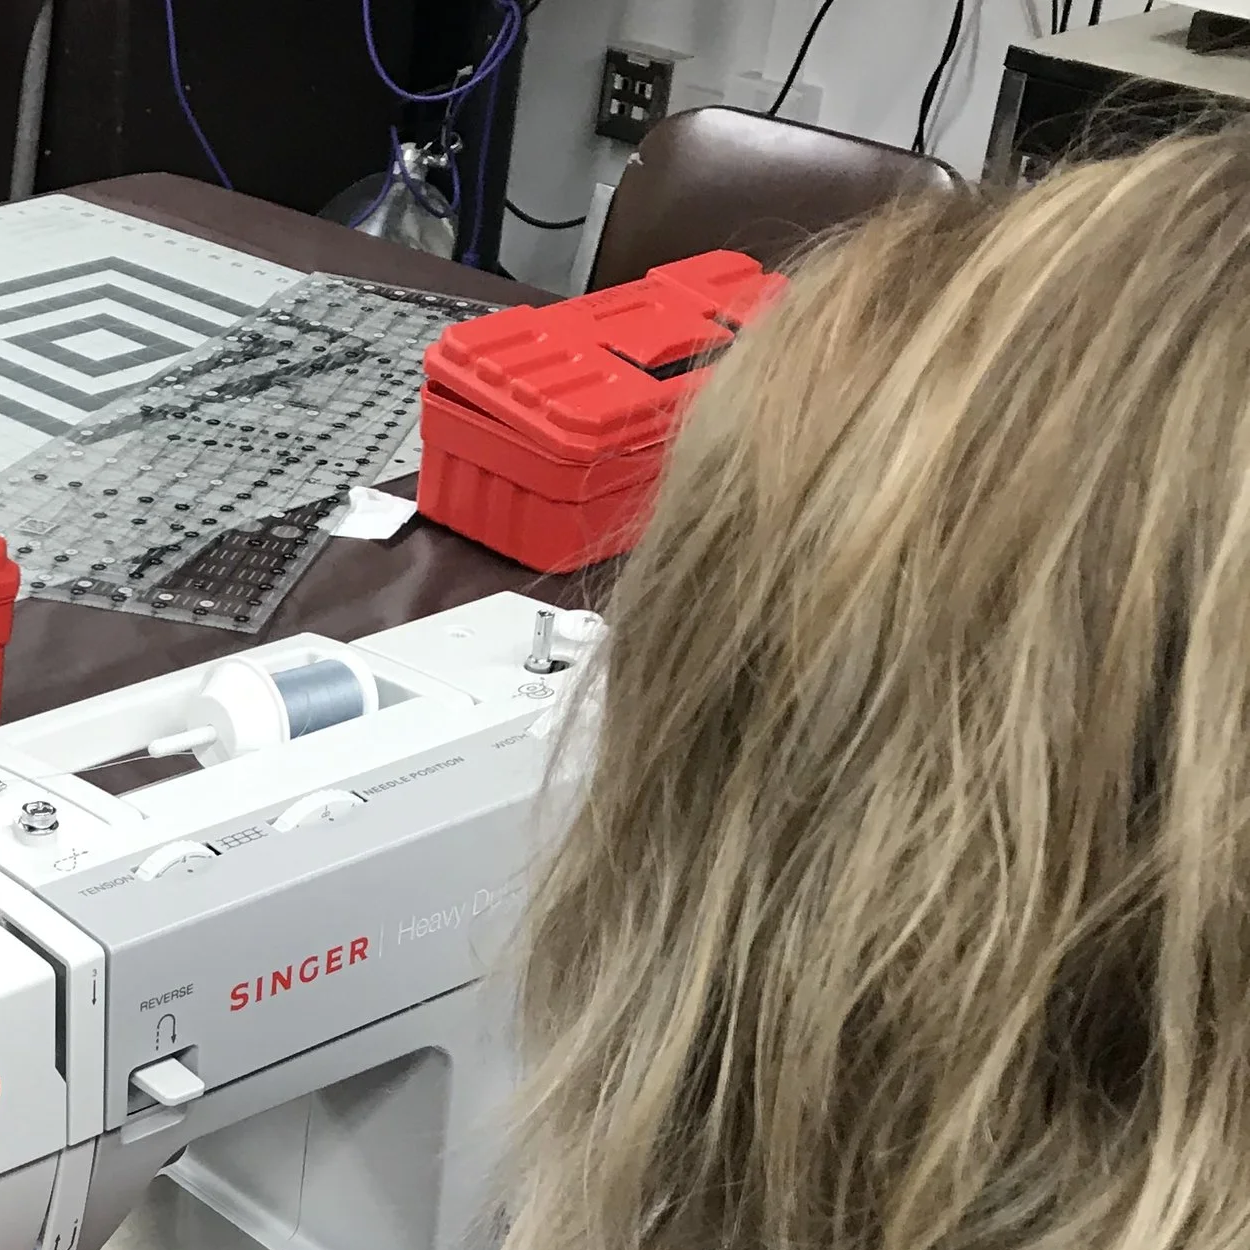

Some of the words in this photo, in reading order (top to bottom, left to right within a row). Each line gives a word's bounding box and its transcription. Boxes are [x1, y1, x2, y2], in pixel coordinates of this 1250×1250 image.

[362, 776, 411, 797] NEEDLE
[408, 755, 466, 780] POSITION
[77, 874, 136, 897] TENSION
[230, 937, 369, 1011] SINGER
[397, 902, 467, 945] Heavy
[140, 983, 194, 1012] REVERSE
